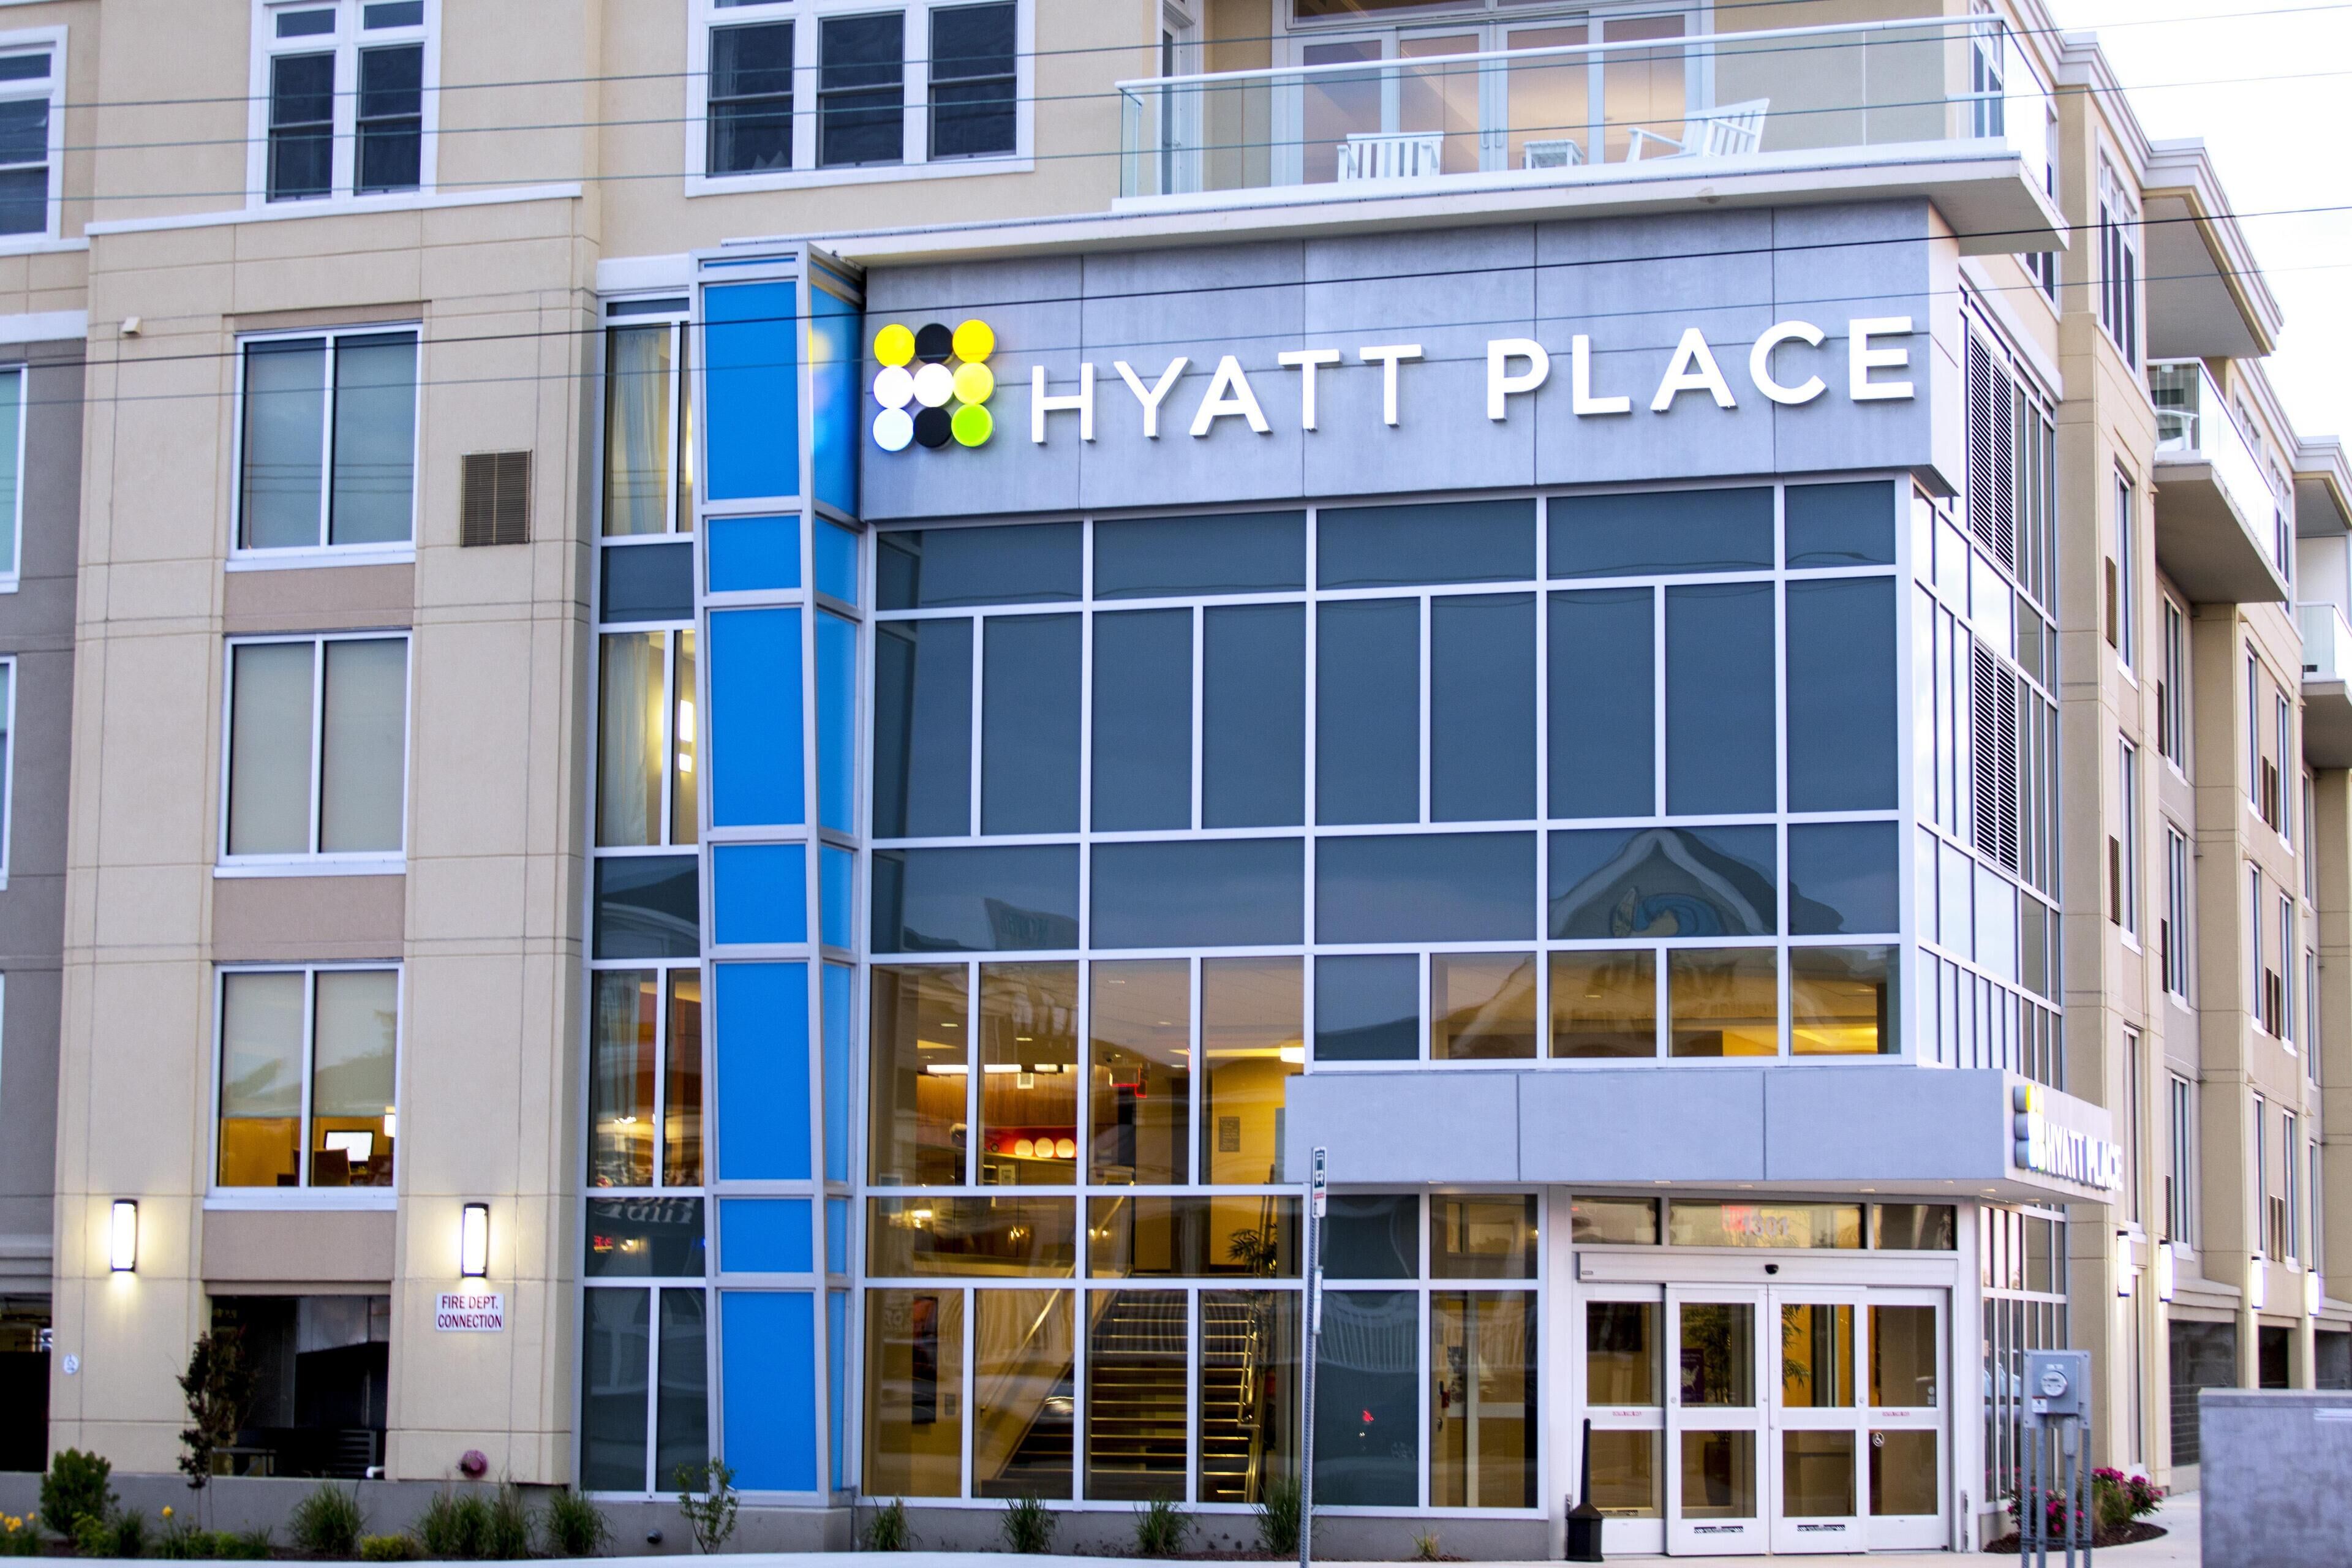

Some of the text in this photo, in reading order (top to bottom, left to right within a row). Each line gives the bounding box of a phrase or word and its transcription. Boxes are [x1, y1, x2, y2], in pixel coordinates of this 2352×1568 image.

[1031, 315, 1915, 445] HYATT PLACE
[2045, 1121, 2124, 1191] HYATT PLACE
[1743, 1215, 1789, 1237] 1301
[442, 1295, 499, 1310] FIRE DEPT.
[438, 1314, 502, 1329] CONNECTION
